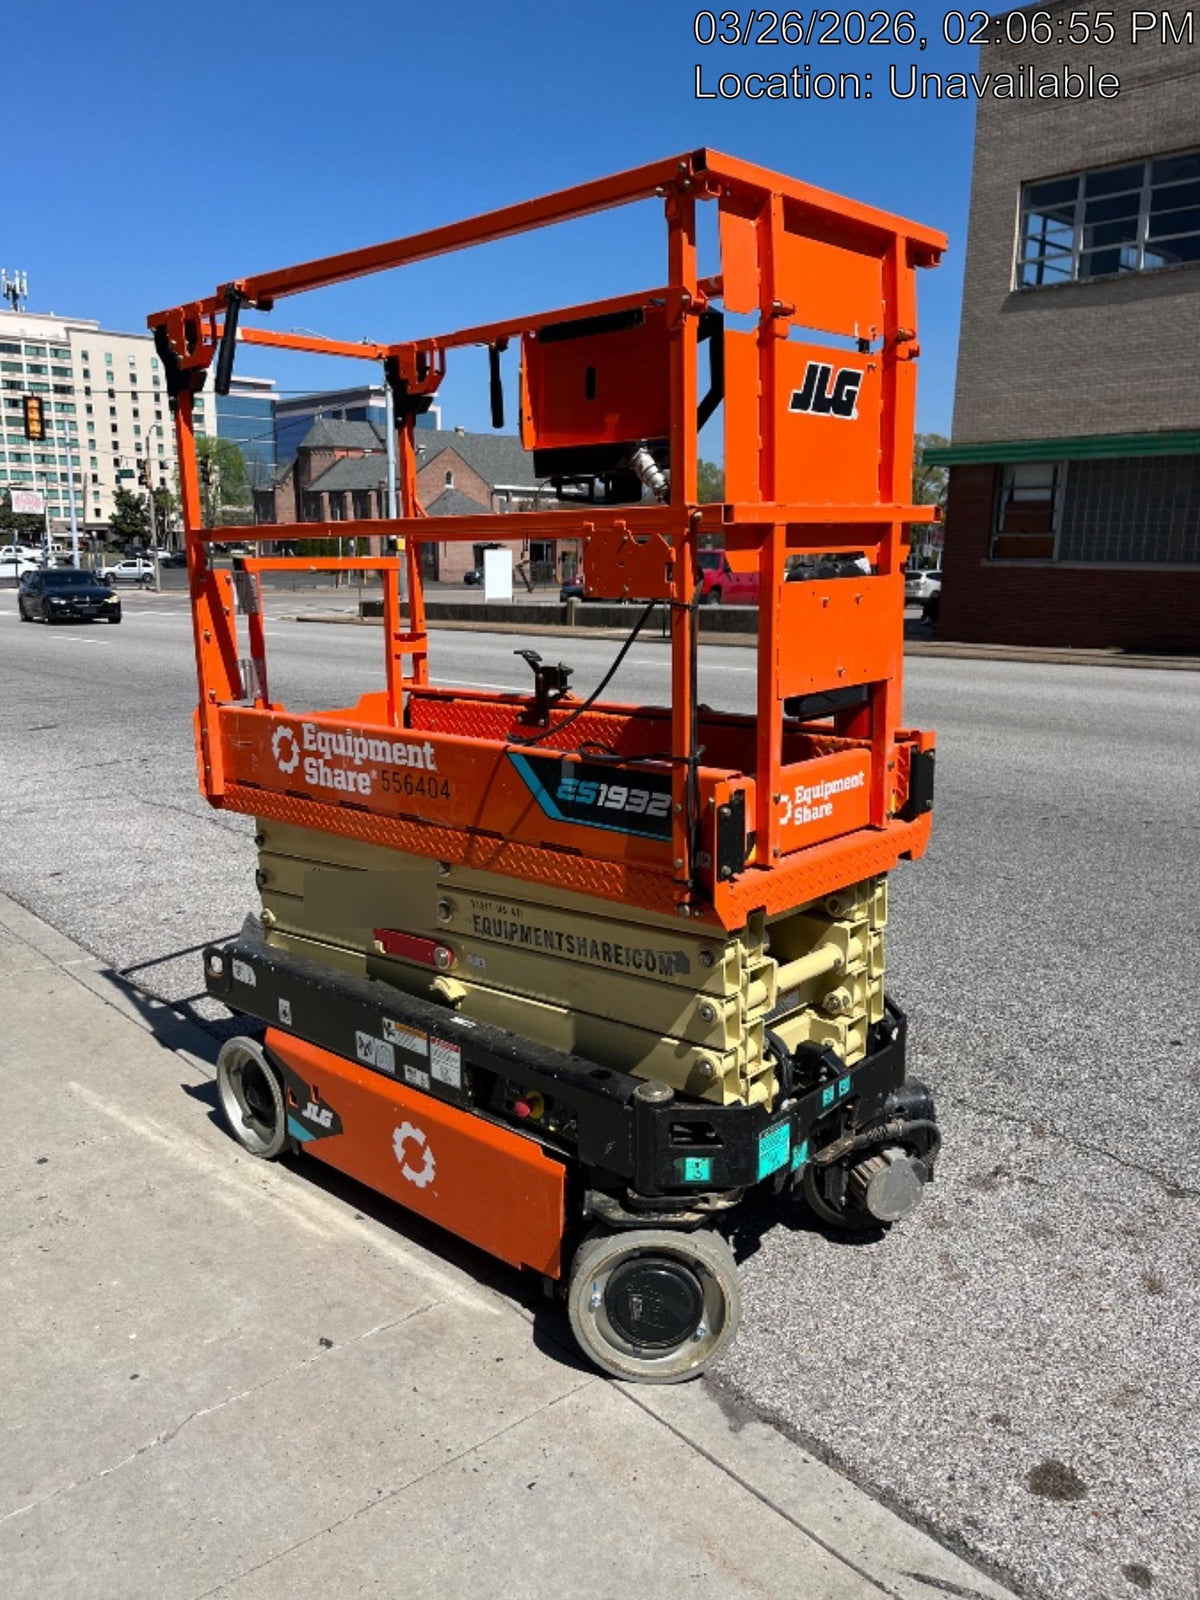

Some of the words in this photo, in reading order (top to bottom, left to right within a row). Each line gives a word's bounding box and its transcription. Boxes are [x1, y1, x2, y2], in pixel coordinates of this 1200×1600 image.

[788, 360, 865, 420] JLG
[301, 722, 437, 770] Equipment
[380, 768, 451, 801] 556404
[556, 777, 672, 817] ES1932
[794, 769, 865, 805] Equipment
[793, 802, 833, 826] Share
[301, 1101, 333, 1128] JLG
